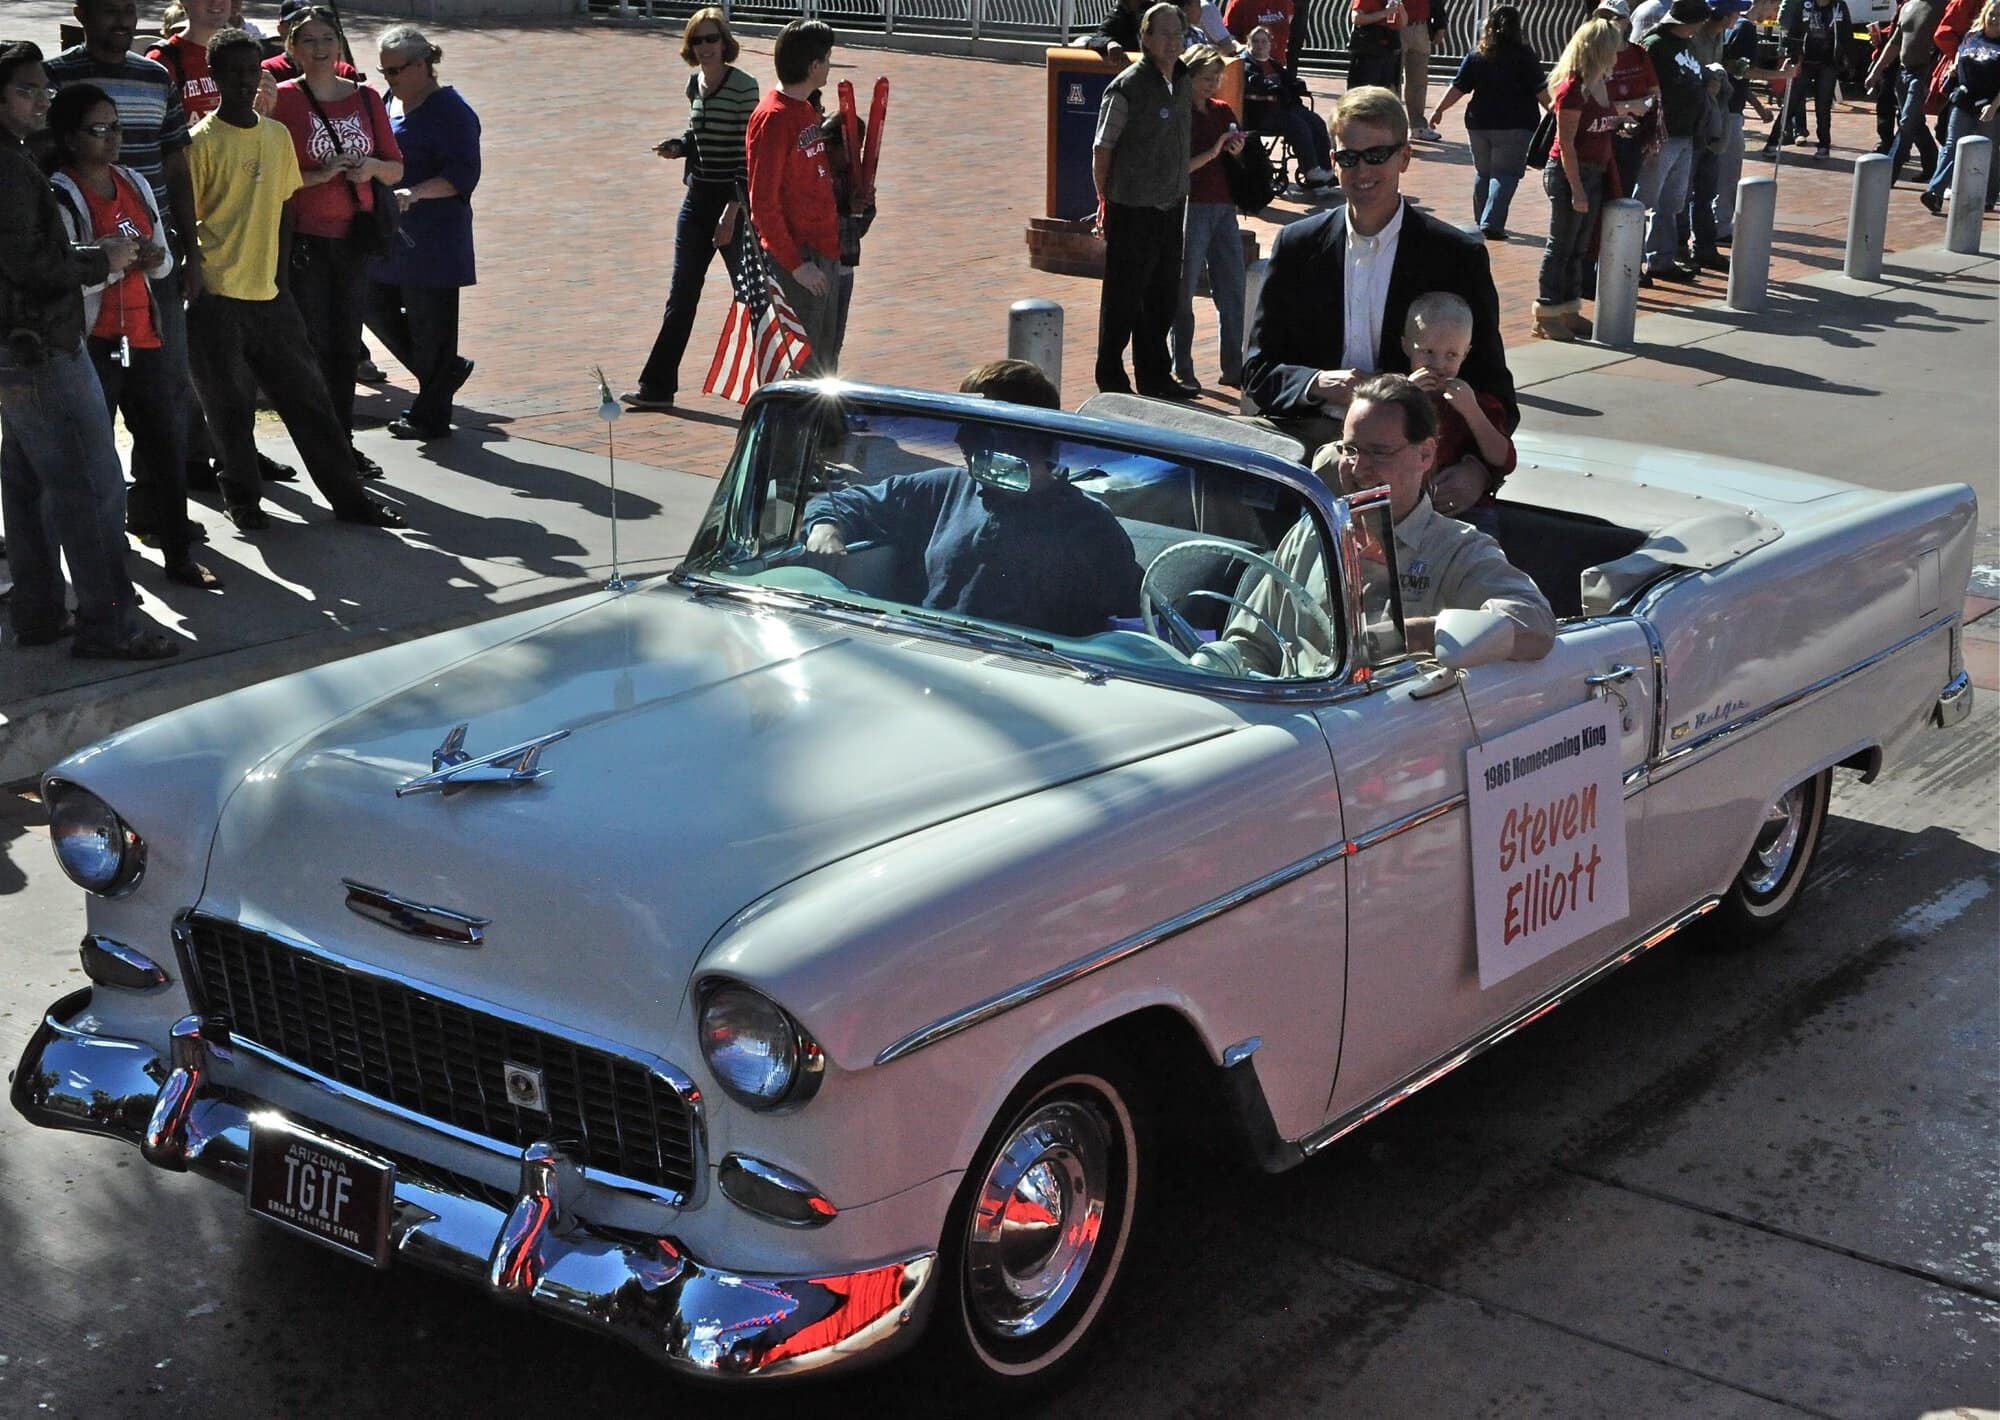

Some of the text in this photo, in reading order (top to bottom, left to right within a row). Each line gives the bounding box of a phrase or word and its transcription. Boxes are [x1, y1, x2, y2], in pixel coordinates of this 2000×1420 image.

[1484, 724, 1607, 791] 1986 Homecoming King
[1499, 783, 1598, 872] Steven
[1504, 844, 1601, 946] Elliott
[284, 1154, 353, 1222] TGIF
[289, 1143, 347, 1174] ARIZONA
[333, 1225, 360, 1244] STATE
